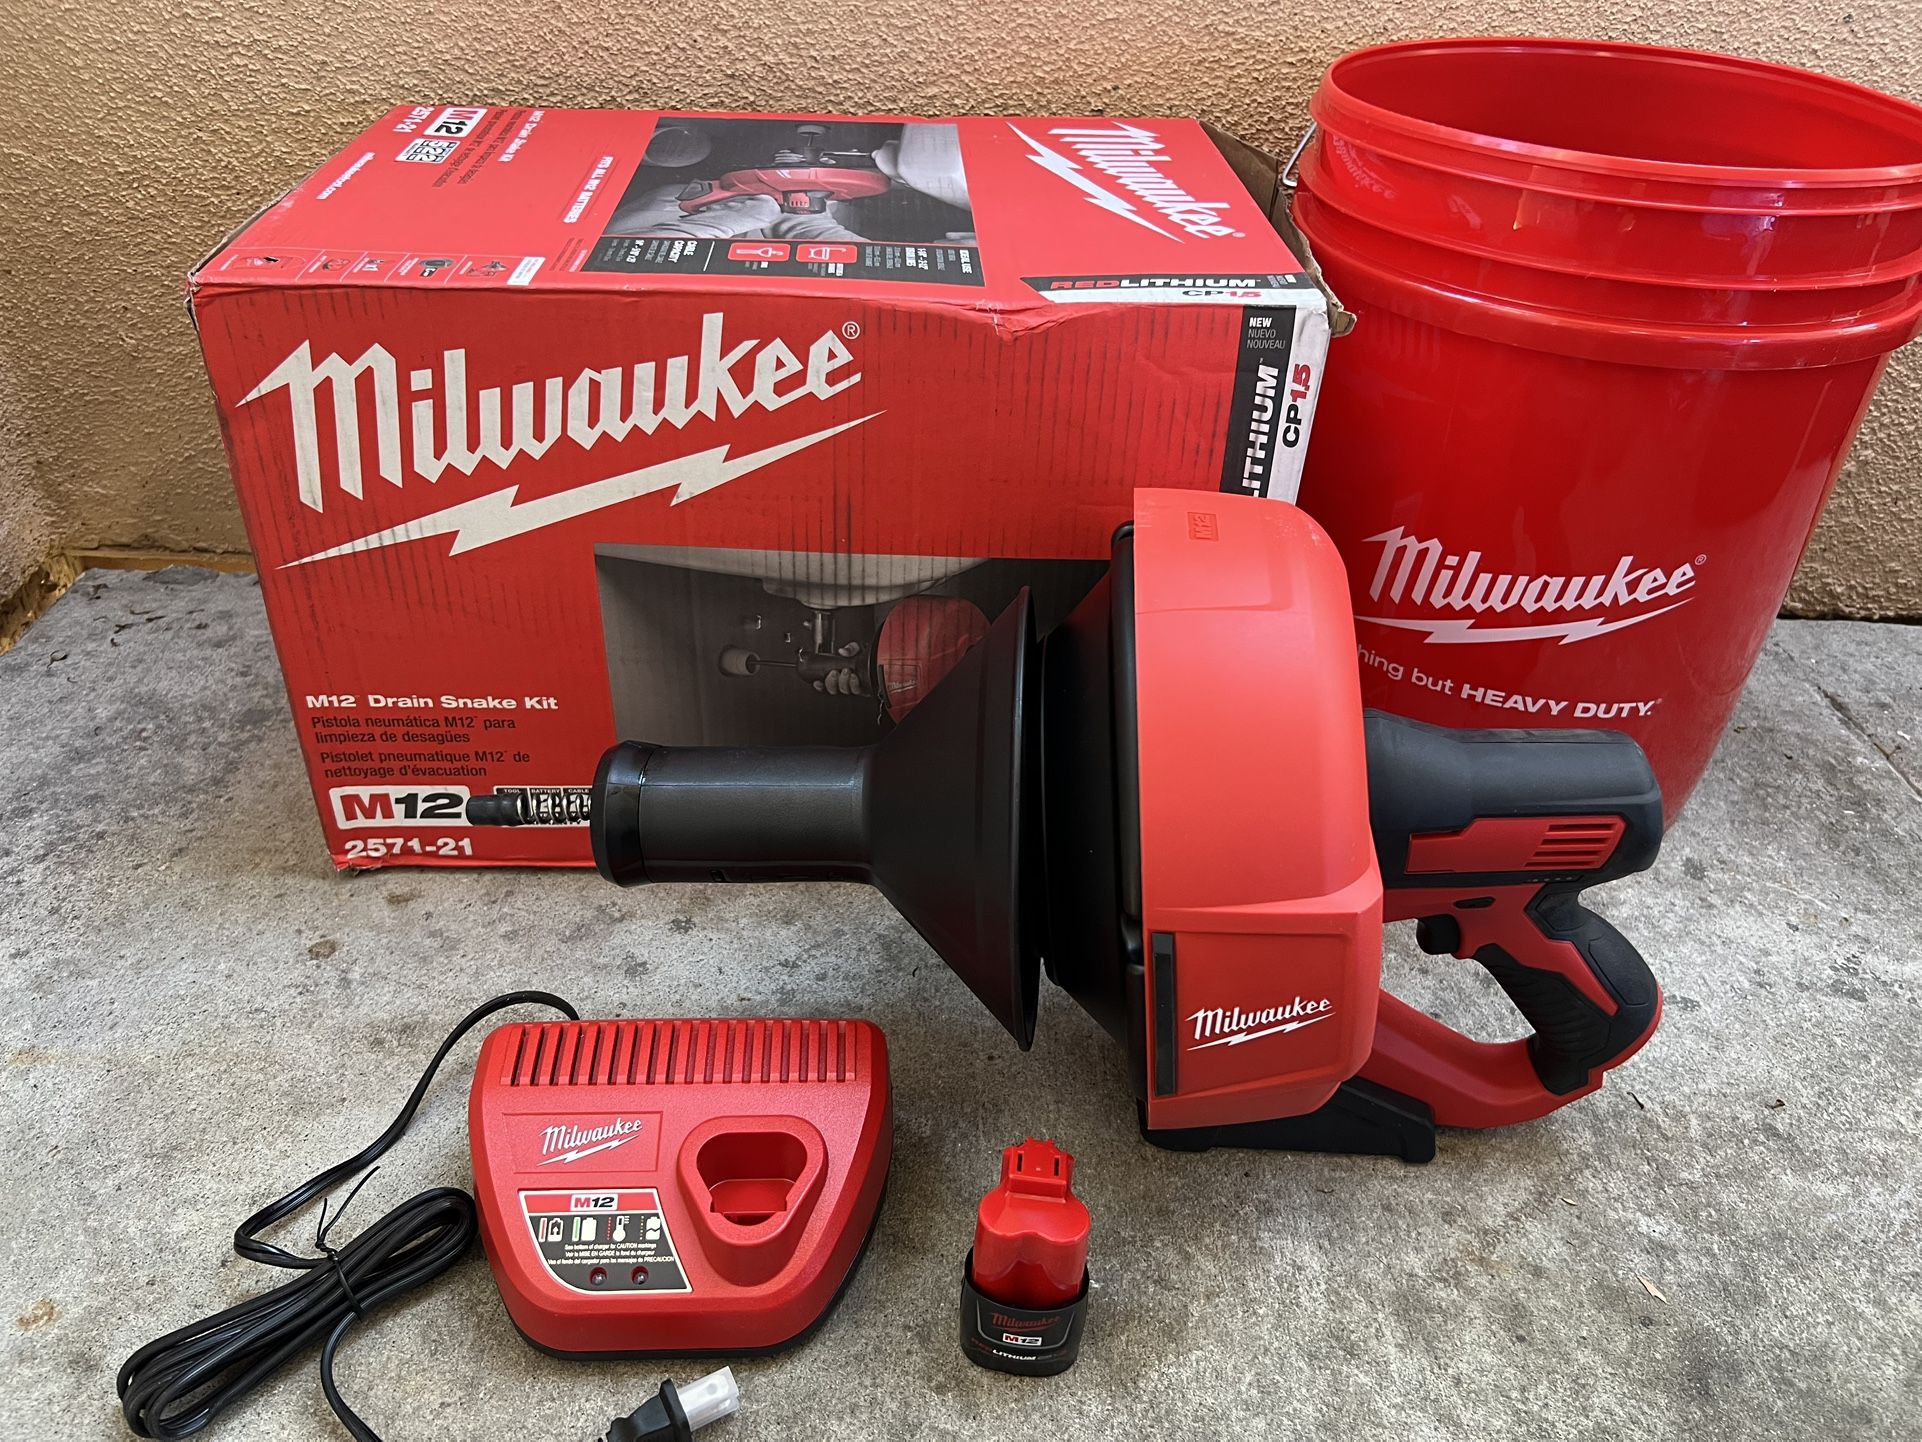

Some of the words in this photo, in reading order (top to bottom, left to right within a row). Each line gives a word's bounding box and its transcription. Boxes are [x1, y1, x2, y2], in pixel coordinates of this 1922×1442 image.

[433, 110, 479, 135] M12
[1249, 317, 1272, 328] NEW
[1248, 329, 1276, 339] NUEVO
[1246, 340, 1286, 350] NOUVEAU
[1357, 643, 1404, 681] hing
[1411, 667, 1454, 695] but
[1460, 683, 1568, 716] HEAVY
[368, 694, 434, 708] Drain
[440, 695, 517, 709] Snake
[524, 696, 559, 710] Kit
[311, 716, 361, 729] Pistola
[365, 715, 440, 729] neumática
[483, 718, 516, 731] para
[315, 731, 376, 745] limpieza
[380, 730, 397, 743] de
[402, 730, 471, 745] desagües
[320, 751, 375, 764] Pistolet
[379, 750, 471, 764] pneumatique
[513, 751, 531, 763] de
[324, 766, 395, 779] nettoyage
[340, 792, 464, 822] M12
[344, 837, 473, 859] 2571-21
[1184, 996, 1333, 1040] Milwaukee
[539, 1117, 643, 1155] Milwaukee
[573, 1197, 615, 1208] M12
[1004, 1334, 1041, 1345] M12
